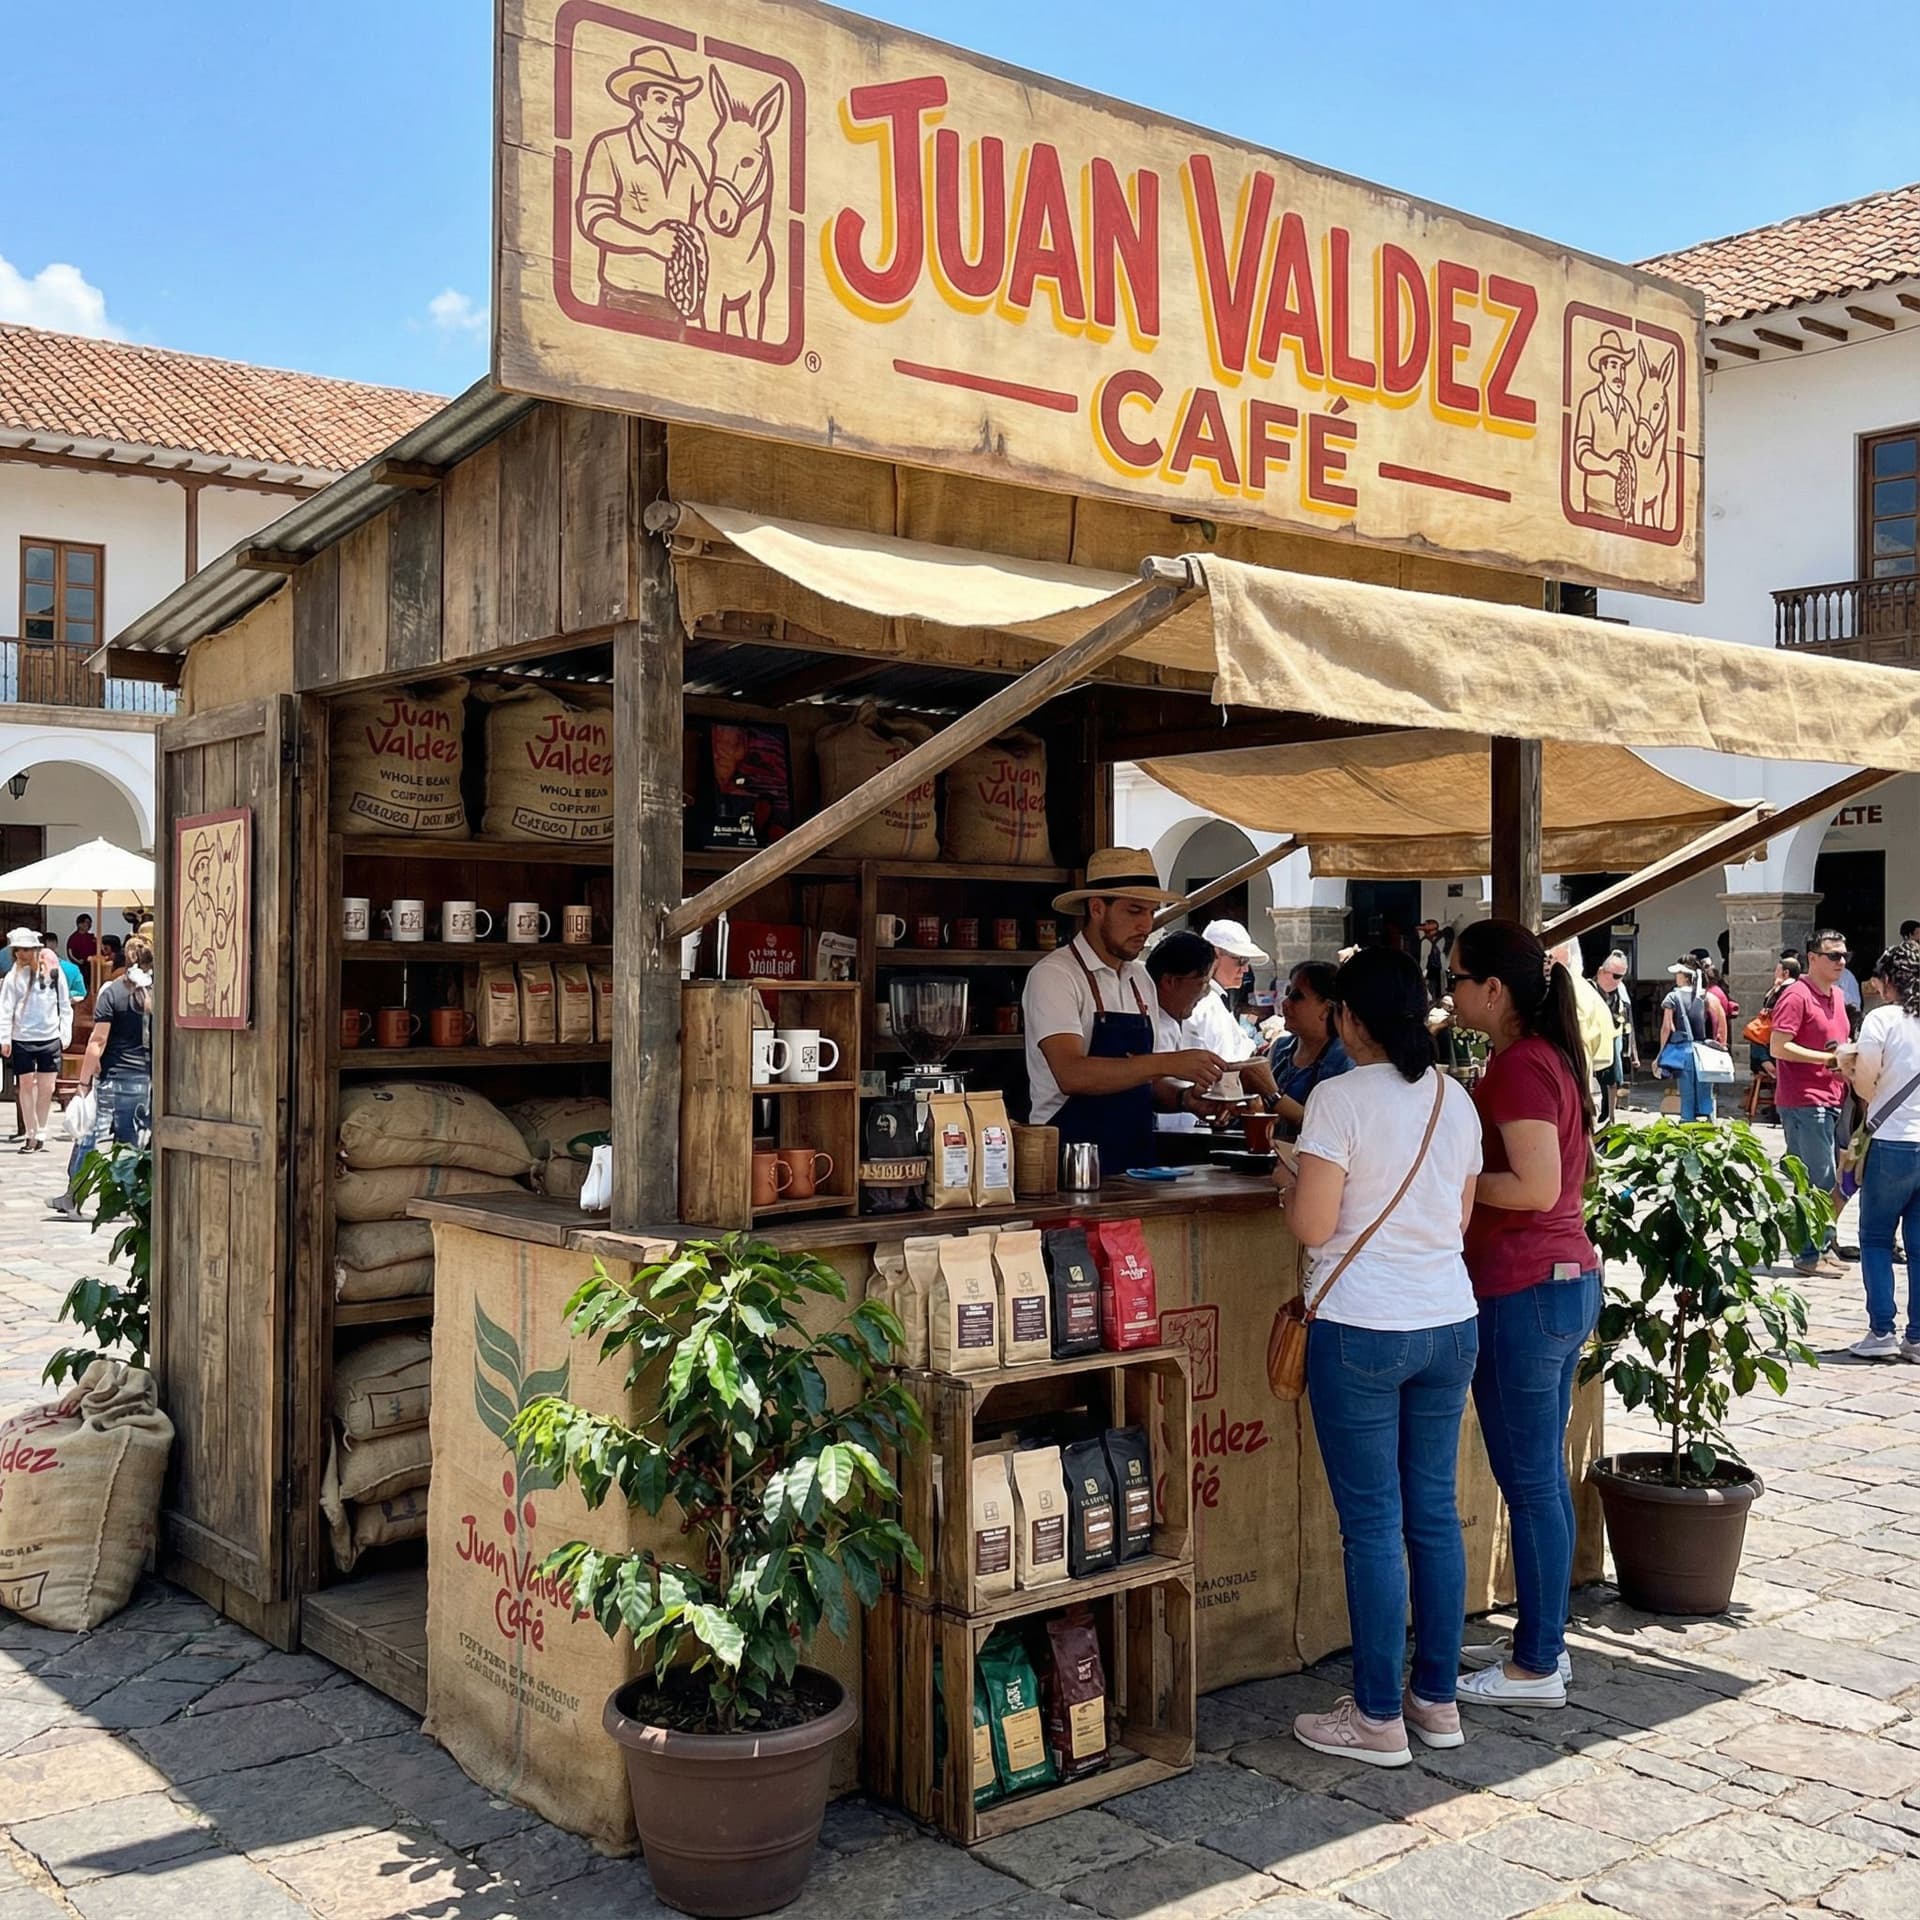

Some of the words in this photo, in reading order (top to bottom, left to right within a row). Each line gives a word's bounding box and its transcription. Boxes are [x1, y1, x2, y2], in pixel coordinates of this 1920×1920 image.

[824, 76, 1160, 345] JUAN
[1184, 153, 1539, 430] VALDEZ
[1094, 368, 1358, 513] CAFÉ
[376, 698, 450, 732] Juan
[535, 714, 606, 747] Juan
[365, 726, 459, 763] Valdez
[380, 769, 424, 787] WHOLE
[986, 759, 1041, 787] Juan
[540, 783, 582, 798] WHOLE
[978, 782, 1047, 812] Valdez
[456, 1515, 510, 1590] Juan
[495, 1588, 545, 1653] Café
